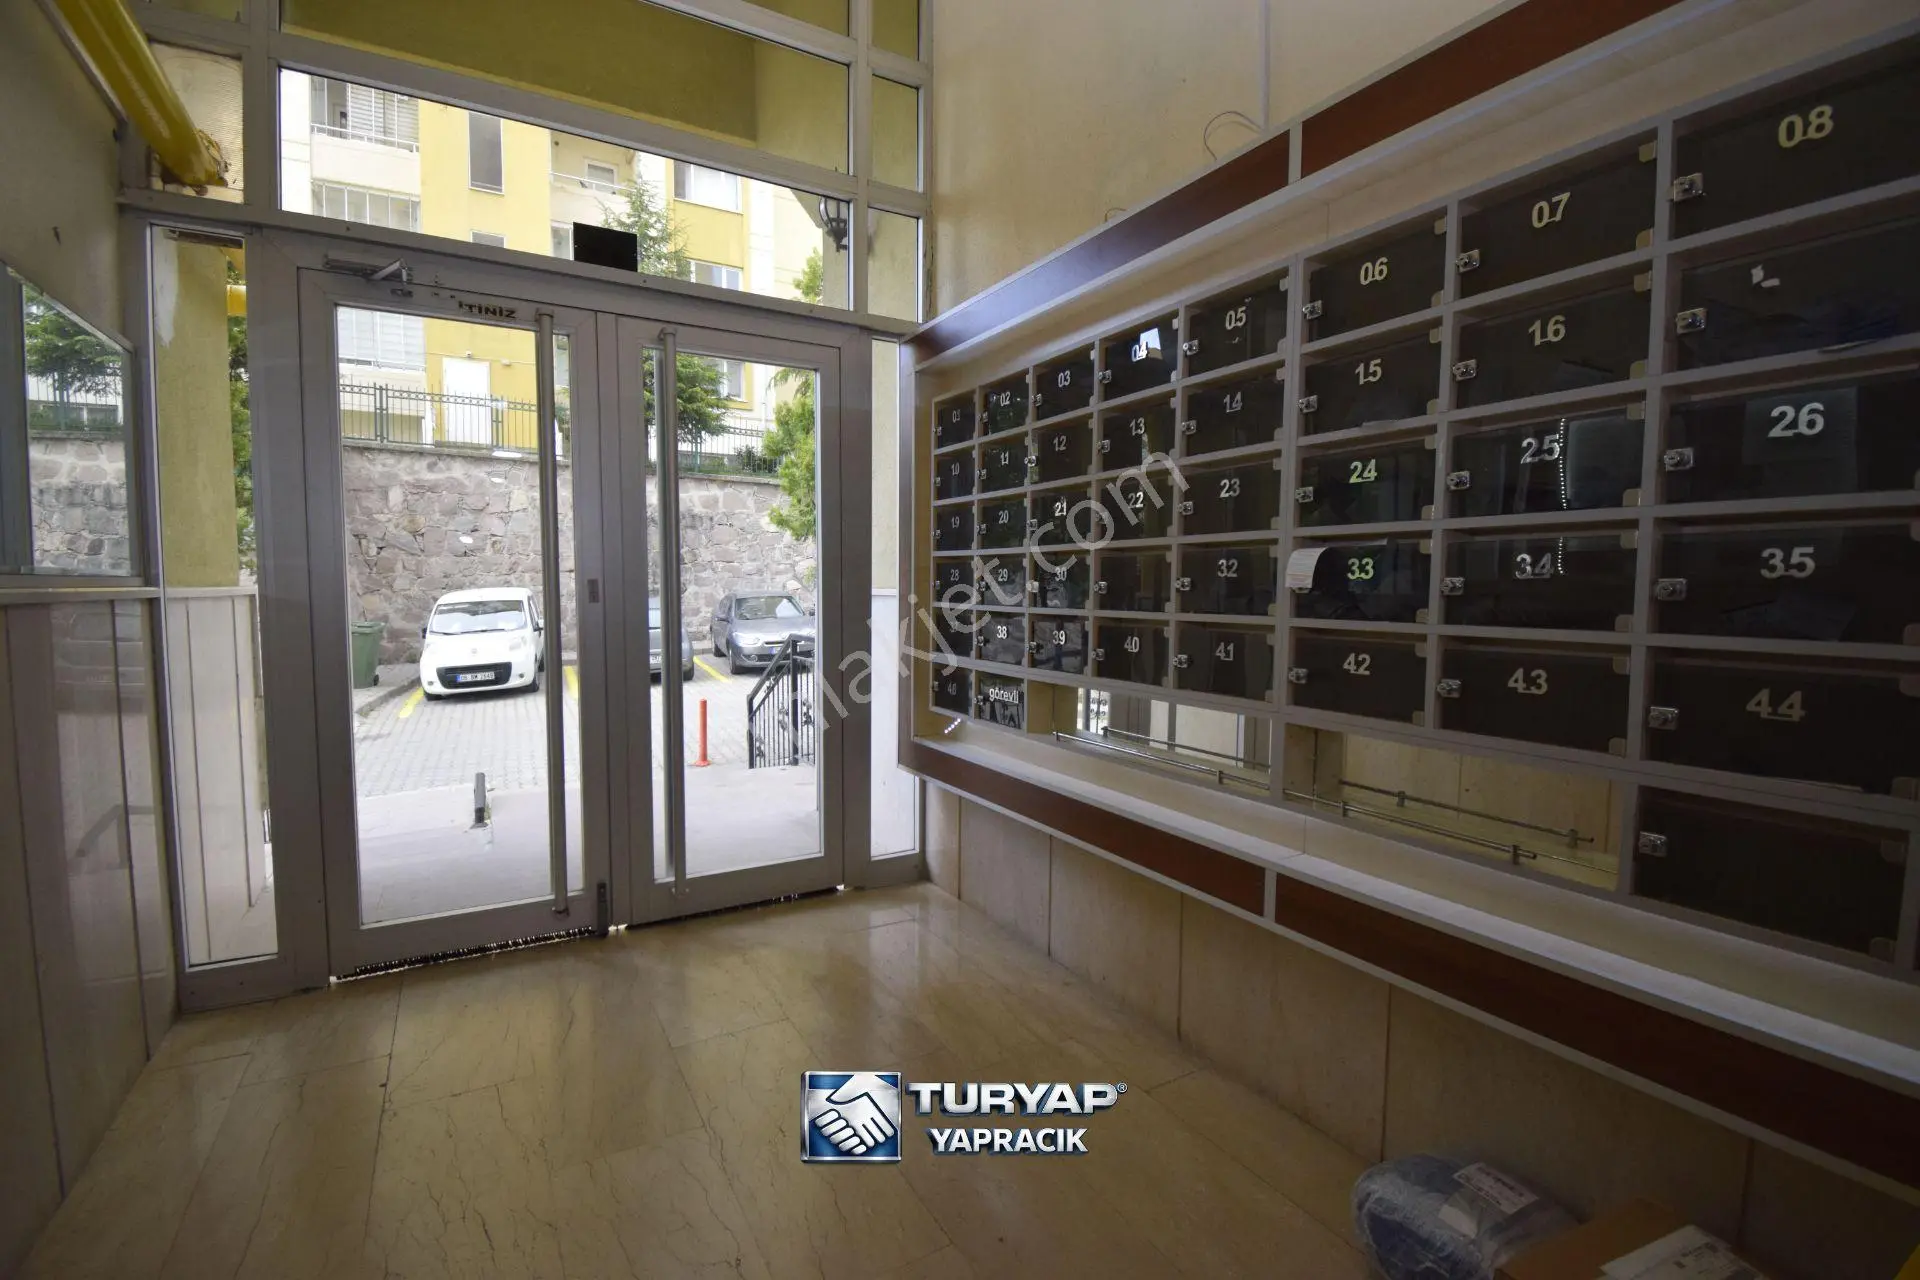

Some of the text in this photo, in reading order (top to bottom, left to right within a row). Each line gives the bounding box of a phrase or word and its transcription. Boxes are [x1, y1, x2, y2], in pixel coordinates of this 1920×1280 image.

[1778, 104, 1834, 148] 08
[1531, 192, 1571, 229] 07
[1360, 257, 1388, 285] 06
[1225, 306, 1247, 330] 05
[1528, 315, 1566, 347] 16
[1057, 370, 1071, 388] 03
[1355, 358, 1382, 385] 15
[1000, 391, 1011, 407] 02
[1223, 392, 1242, 413] 14
[1129, 417, 1145, 436] 13
[1767, 402, 1825, 438] 26
[1053, 435, 1067, 451] 12
[1520, 434, 1560, 464] 25
[1000, 452, 1009, 465] 11
[951, 462, 960, 476] 10
[1349, 458, 1377, 484] 24
[1219, 478, 1240, 498] 23
[1054, 501, 1067, 516] 21
[1128, 491, 1144, 508] 22
[999, 510, 1009, 524] 20
[1217, 559, 1238, 578] 32
[1347, 557, 1374, 581] 33
[1515, 553, 1554, 579] 34
[1760, 547, 1816, 579] 35
[950, 569, 960, 581] 28
[998, 568, 1008, 582] 29
[1054, 567, 1067, 582] 30
[996, 626, 1007, 640] 38
[1052, 630, 1066, 645] 39
[1124, 636, 1140, 653] 40
[1215, 642, 1234, 661] 41
[1343, 652, 1371, 676] 42
[1507, 668, 1548, 695] 43
[1745, 688, 1806, 722] 44
